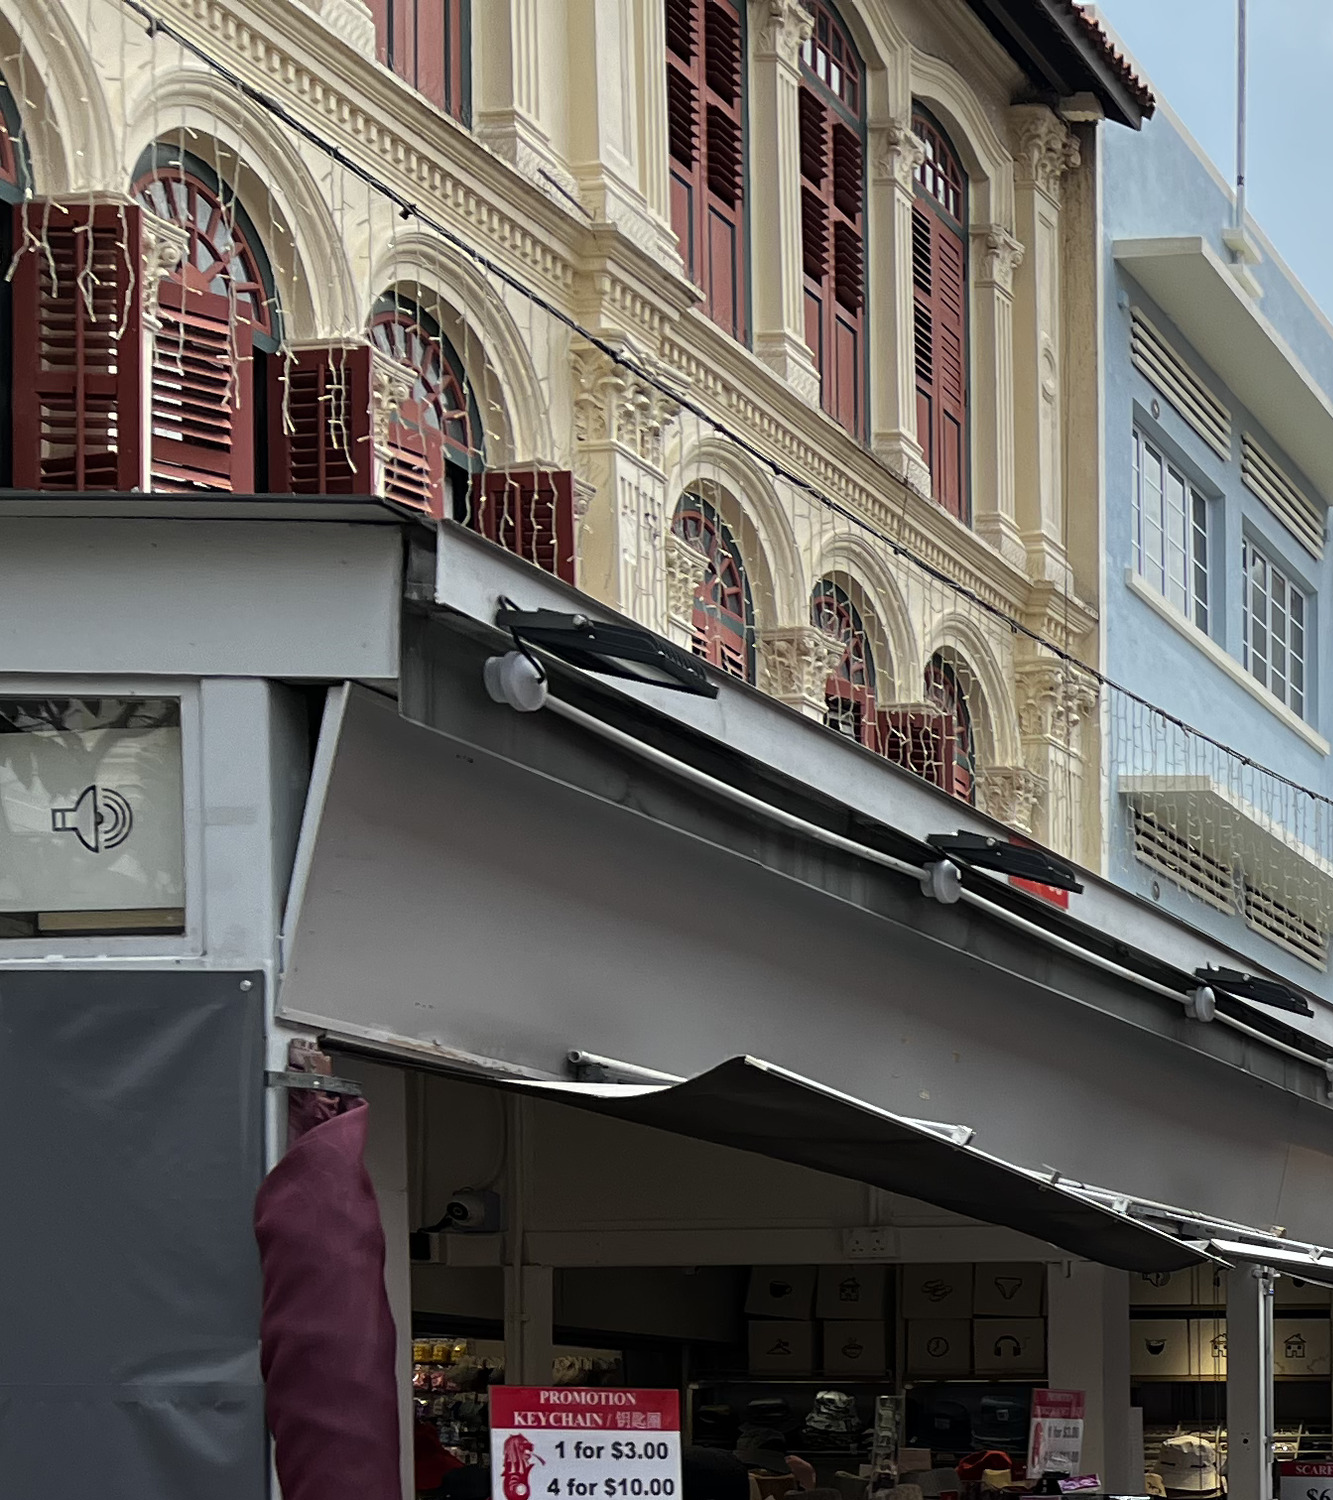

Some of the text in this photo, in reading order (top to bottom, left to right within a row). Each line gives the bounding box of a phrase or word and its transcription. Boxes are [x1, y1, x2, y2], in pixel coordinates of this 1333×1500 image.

[539, 1390, 638, 1406] PROMOTION
[513, 1410, 603, 1428] KEYCHAIN
[555, 1440, 669, 1461] 1 for $3.00
[1296, 1465, 1333, 1475] SCARF
[547, 1478, 675, 1498] 4 for $10.00
